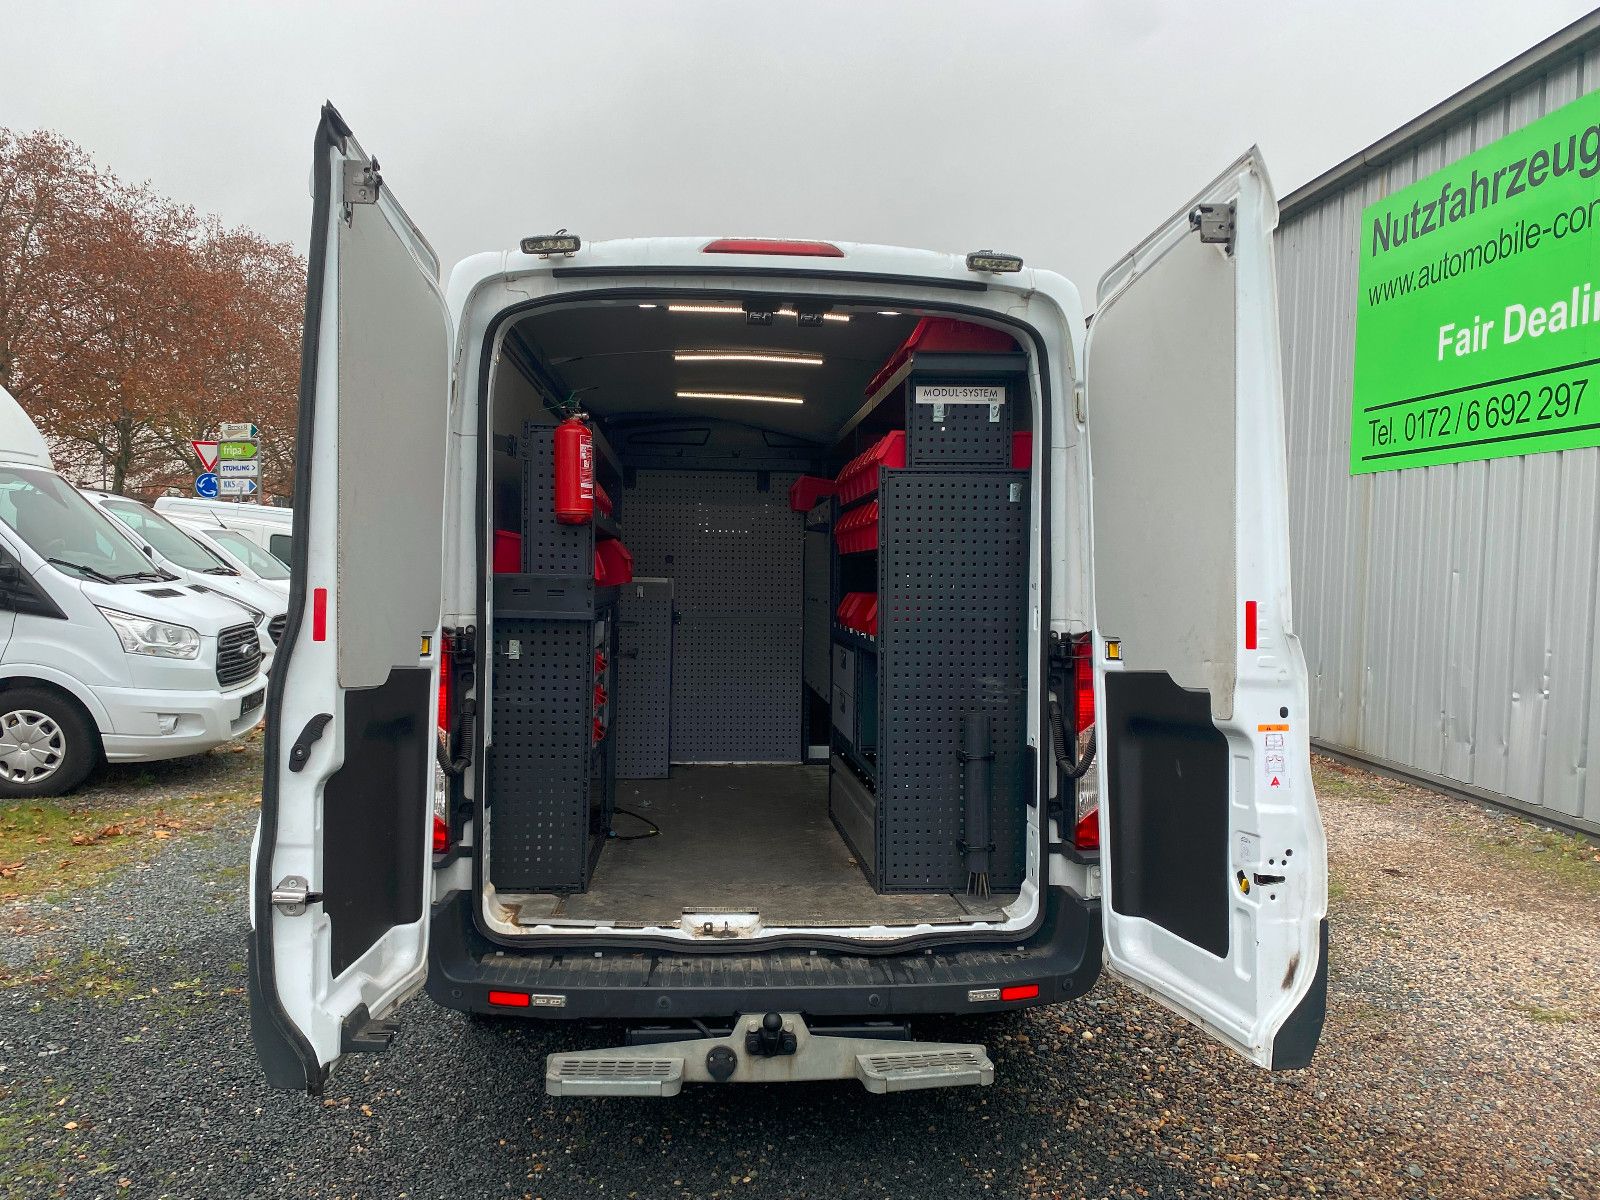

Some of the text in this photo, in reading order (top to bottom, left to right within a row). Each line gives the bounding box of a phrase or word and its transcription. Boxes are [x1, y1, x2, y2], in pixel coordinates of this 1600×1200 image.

[1438, 315, 1495, 362] Fair
[923, 388, 998, 397] MODUL-SYSTEM
[1368, 417, 1397, 447] Tel.
[1536, 378, 1589, 421] 297
[224, 445, 242, 456] fripa
